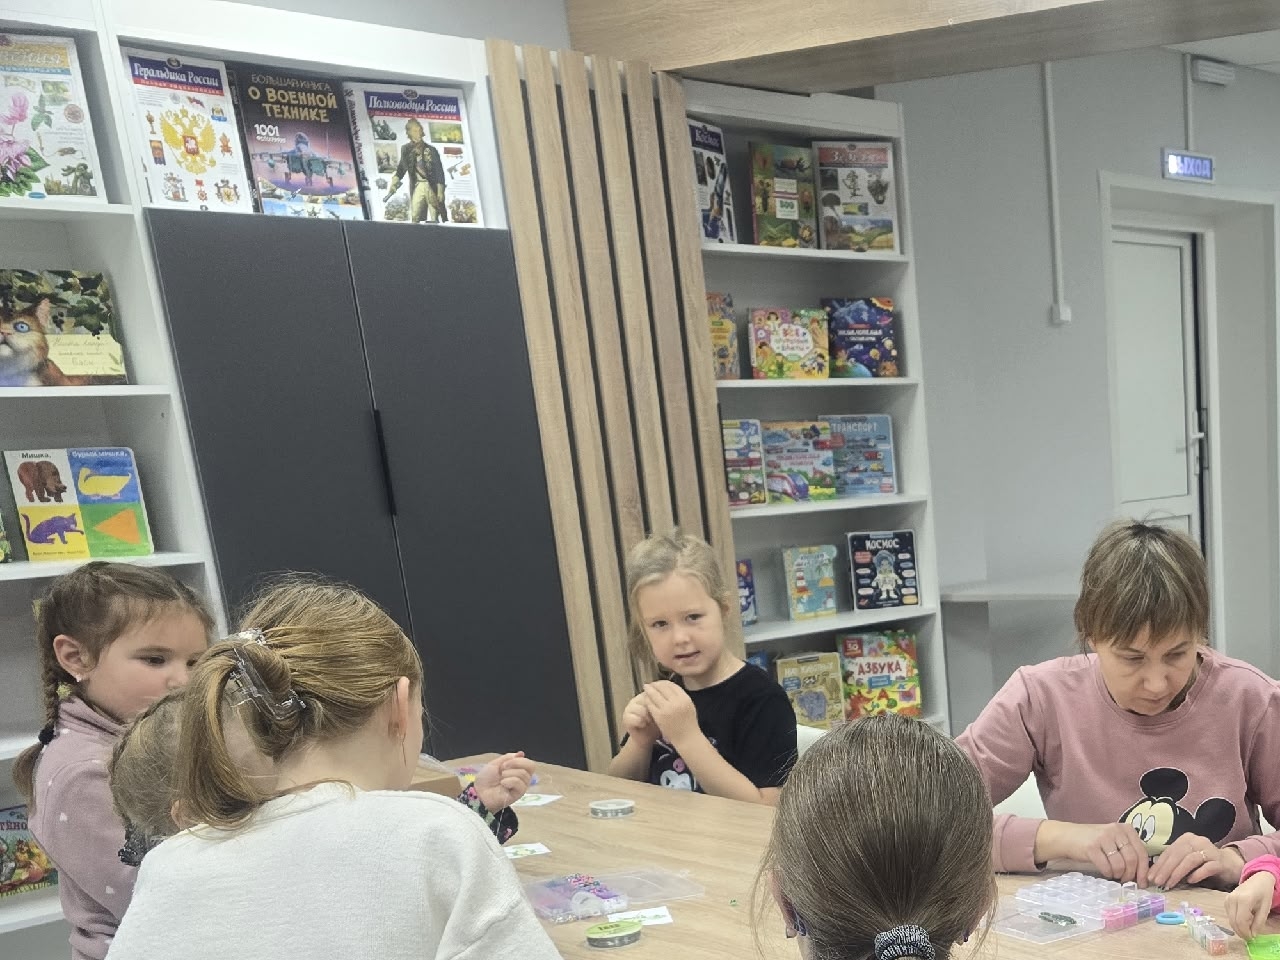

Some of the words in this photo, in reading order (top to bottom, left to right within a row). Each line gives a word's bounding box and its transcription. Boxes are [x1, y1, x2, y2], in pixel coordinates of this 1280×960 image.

[133, 62, 186, 82] Геральдика
[187, 71, 219, 87] России
[247, 86, 261, 100] О
[266, 87, 338, 109] ВОЕННОЙ
[425, 99, 457, 113] России
[262, 103, 329, 123] ТЕХНИКЕ
[254, 123, 280, 137] 1001
[1168, 154, 1211, 179] ЫХОД
[864, 538, 900, 551] КОСМОС
[857, 660, 903, 676] АЗБУКА
